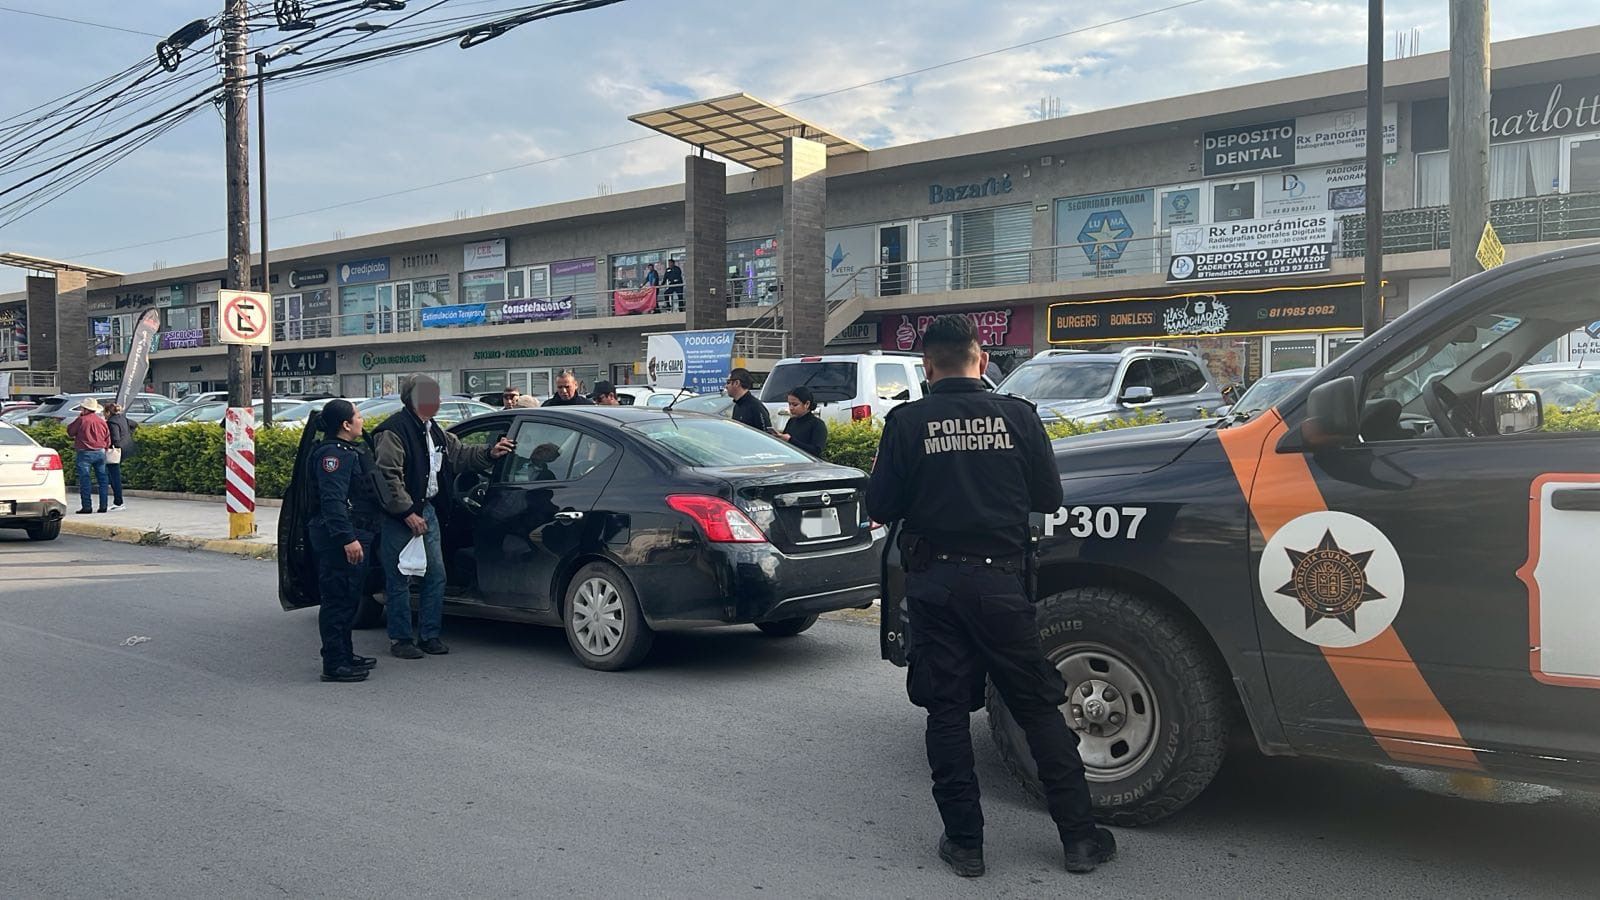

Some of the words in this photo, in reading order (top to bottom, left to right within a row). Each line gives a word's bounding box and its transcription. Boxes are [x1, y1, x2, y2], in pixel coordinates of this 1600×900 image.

[1206, 126, 1293, 150] DEPOSITO
[1296, 136, 1311, 144] Rx
[1216, 146, 1282, 166] DENTAL
[1068, 198, 1110, 211] SEGURIDAD
[1112, 193, 1145, 206] PRIVADA
[1209, 227, 1226, 237] Rx
[1232, 218, 1326, 235] Panorámicas
[1292, 227, 1326, 236] Digitales
[402, 253, 439, 268] DENTISTA
[1196, 251, 1267, 264] DEPOSITO
[1272, 244, 1328, 259] DENTAL
[1197, 263, 1242, 271] CADEREYTA
[1287, 255, 1326, 264] CAVAZOS
[502, 300, 572, 314] Constelaciones
[1269, 308, 1280, 317] 81
[1282, 307, 1306, 316] 1985
[1307, 305, 1335, 315] 8982
[1057, 315, 1097, 328] BURGERS
[1110, 313, 1153, 326] BONELESS
[685, 333, 730, 346] PODOLOGÍA
[298, 354, 316, 370] 4U
[668, 360, 683, 371] GUAPO
[95, 370, 115, 381] SUSHI
[924, 433, 1014, 454] MUNICIPAL
[1045, 506, 1147, 539] P307
[1321, 552, 1362, 589] GUADALUPE
